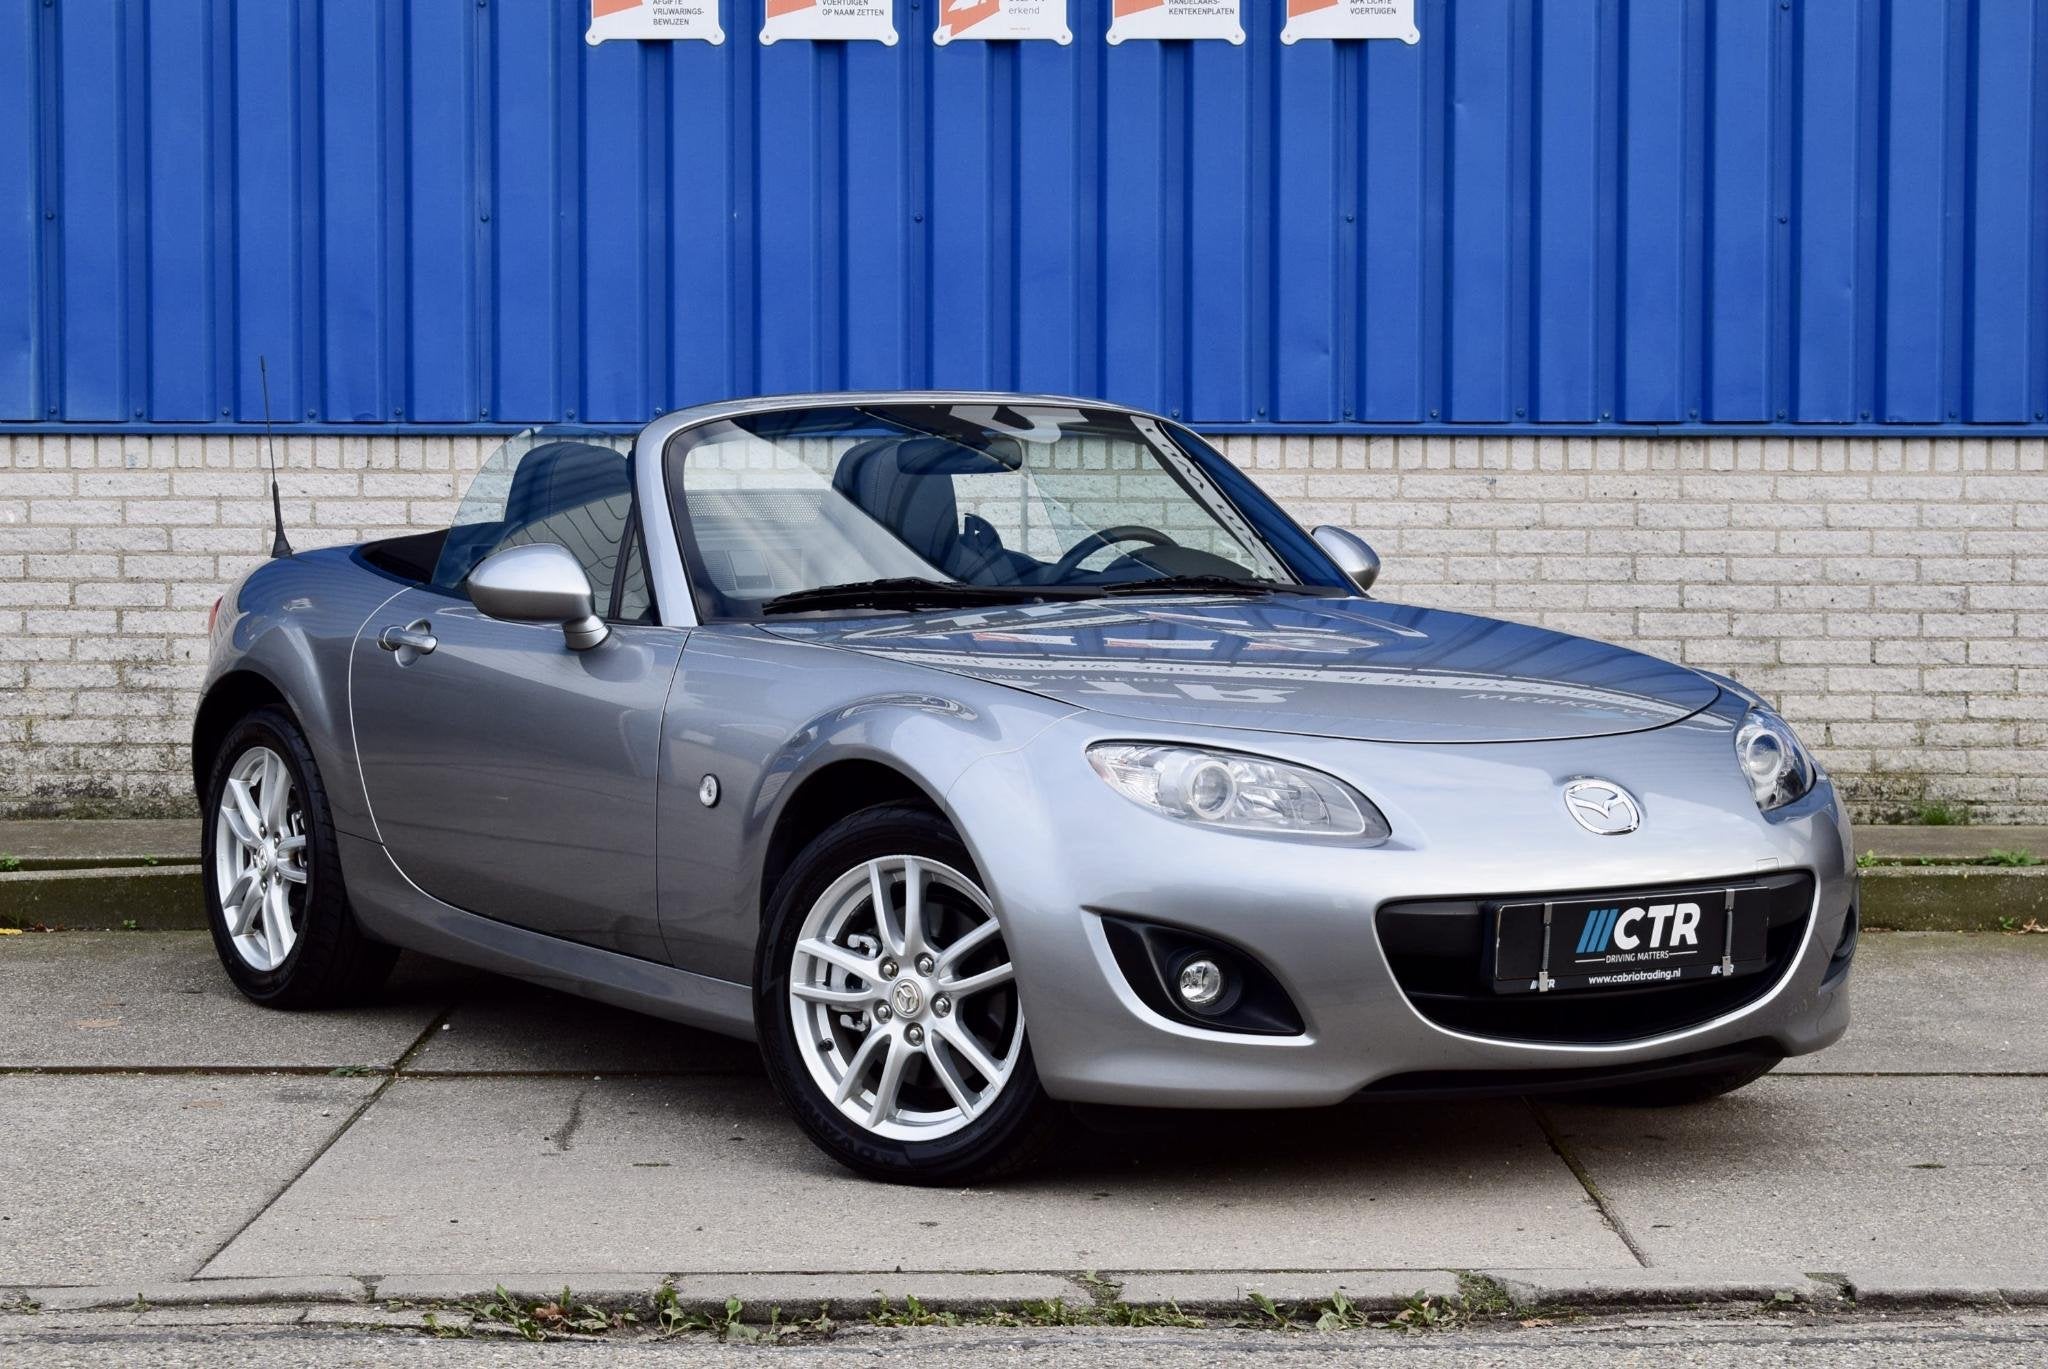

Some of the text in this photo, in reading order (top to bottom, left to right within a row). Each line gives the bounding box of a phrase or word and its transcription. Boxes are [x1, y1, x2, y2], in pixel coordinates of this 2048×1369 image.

[652, 7, 705, 15] VRIJWARINGS-
[822, 8, 884, 16] OP NAAM ZETTEN
[1008, 6, 1040, 15] erkend
[1168, 7, 1235, 15] KENTEKENPLATEN
[1349, 7, 1397, 15] VOERTUIGEN
[653, 18, 690, 26] BEWIJZEN
[1613, 902, 1701, 951] CTR
[1605, 949, 1670, 964] DRIVING MATTERS
[1588, 967, 1682, 985] www.cabriotrading.nl
